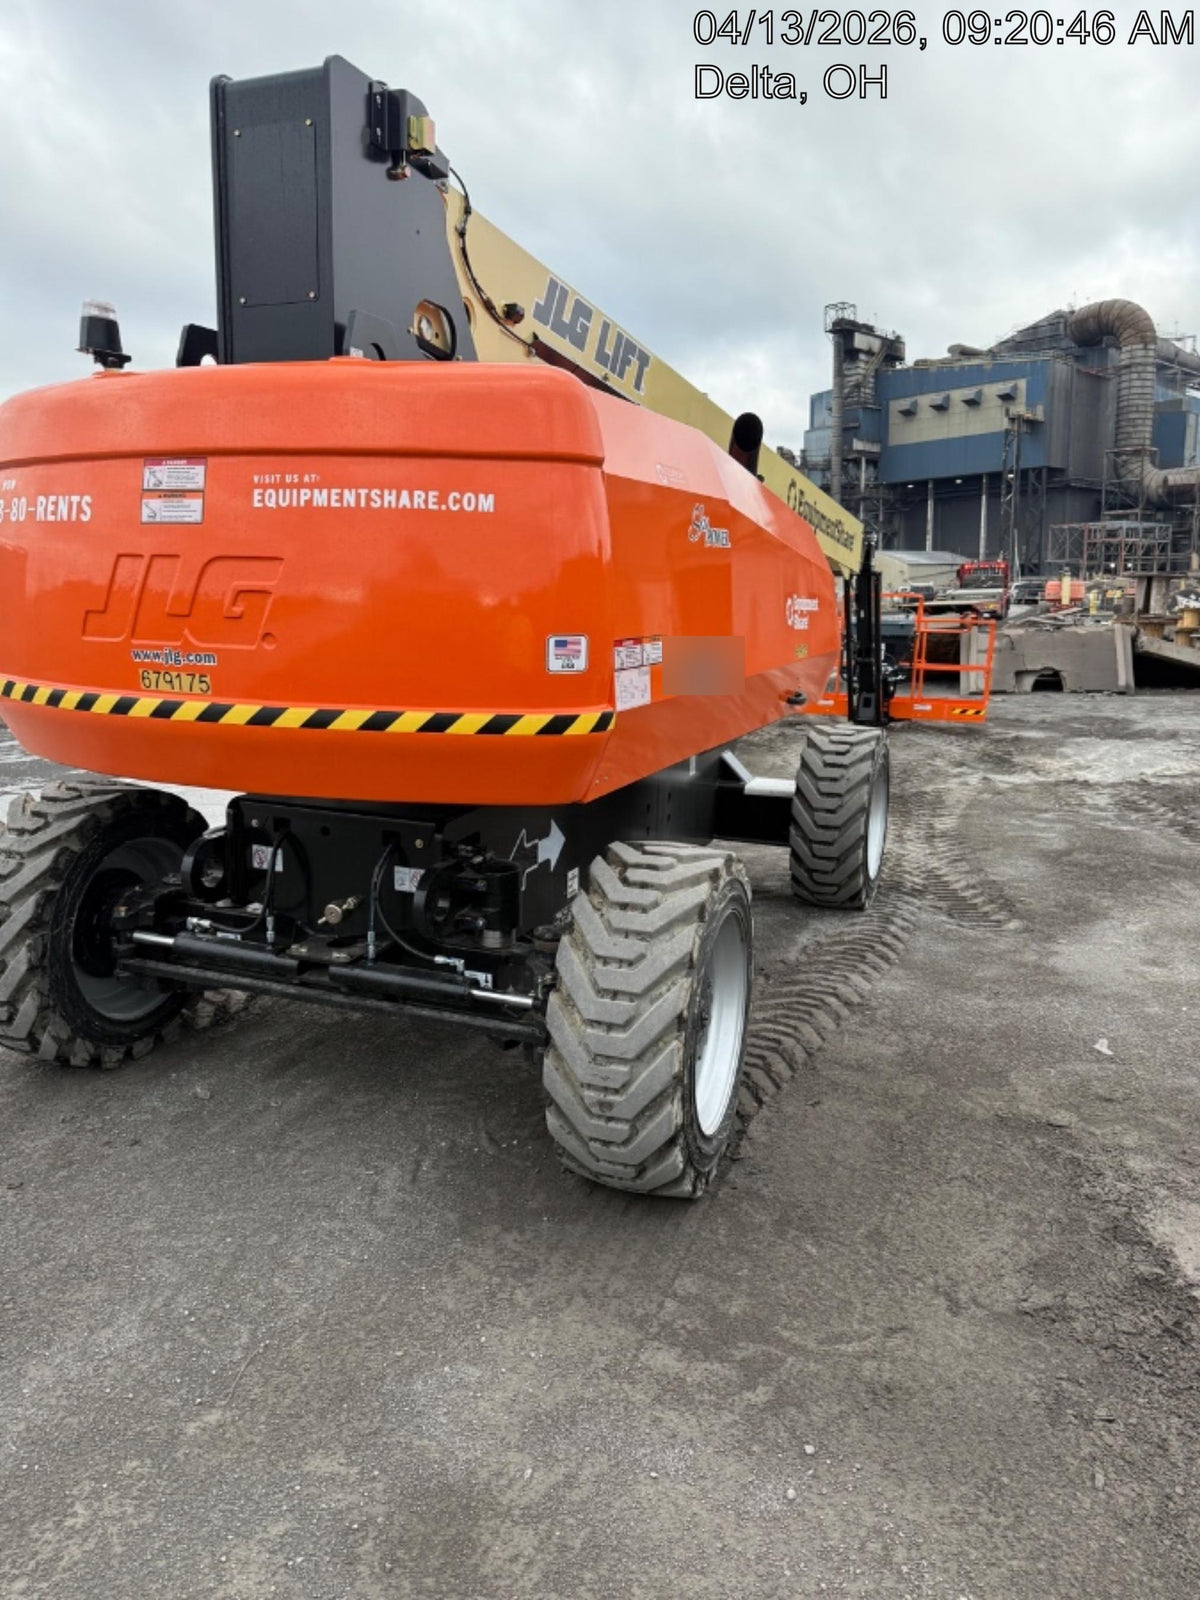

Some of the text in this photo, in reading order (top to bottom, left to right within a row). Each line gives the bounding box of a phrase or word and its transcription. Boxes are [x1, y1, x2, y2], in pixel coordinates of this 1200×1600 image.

[532, 276, 651, 393] JLG LIFT
[253, 474, 281, 484] VISIT
[285, 474, 299, 483] US
[253, 488, 496, 513] EQUIPMENTSHARE.COM
[131, 648, 218, 667] www.jlg.com
[140, 670, 211, 694] 679175
